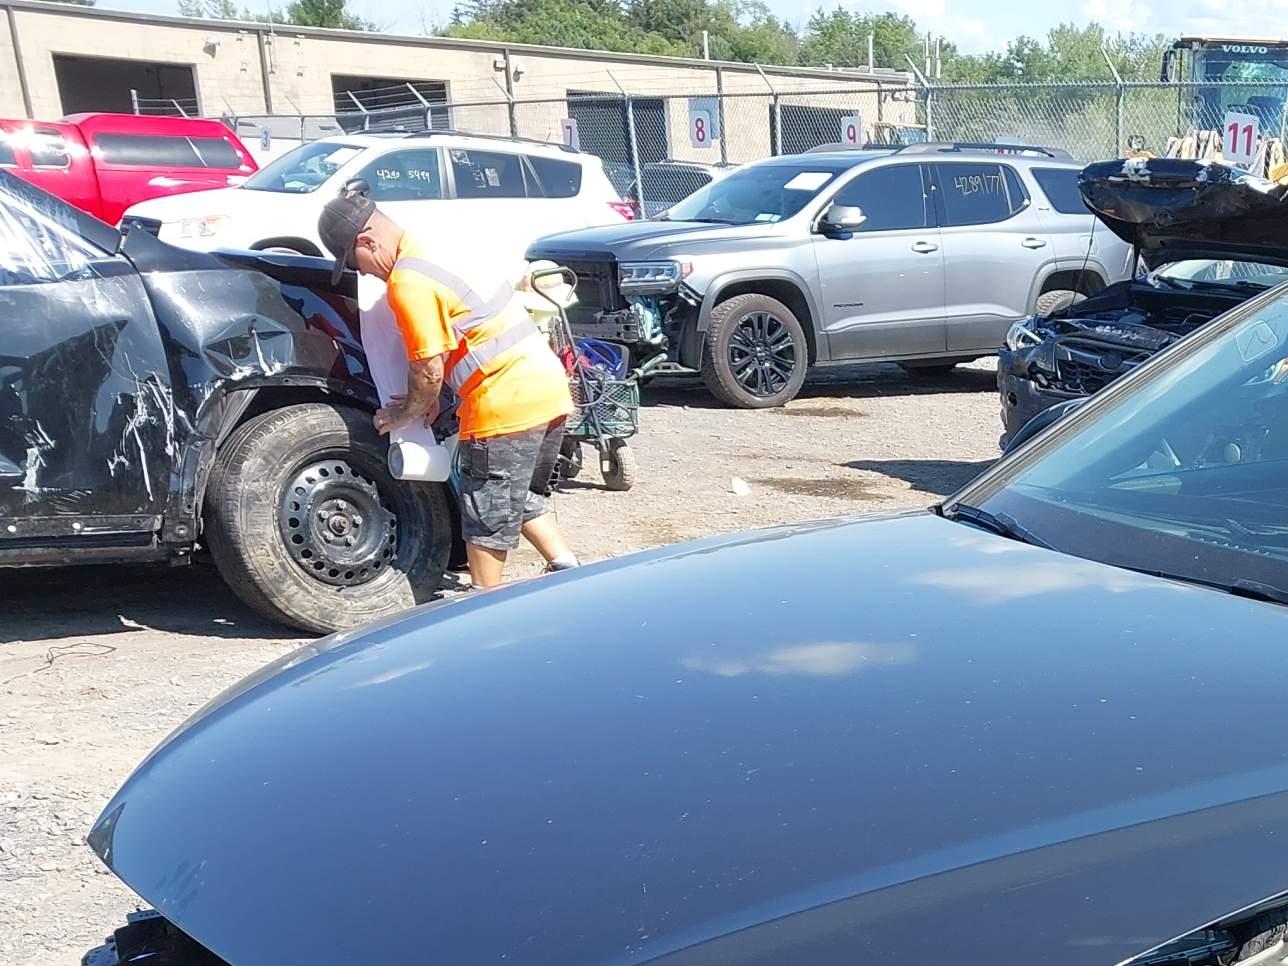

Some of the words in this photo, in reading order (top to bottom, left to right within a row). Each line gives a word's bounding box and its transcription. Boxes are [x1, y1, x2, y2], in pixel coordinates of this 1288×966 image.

[1222, 45, 1268, 54] VOLVO
[695, 117, 706, 143] 8
[846, 124, 856, 144] 9
[1228, 122, 1253, 156] 11
